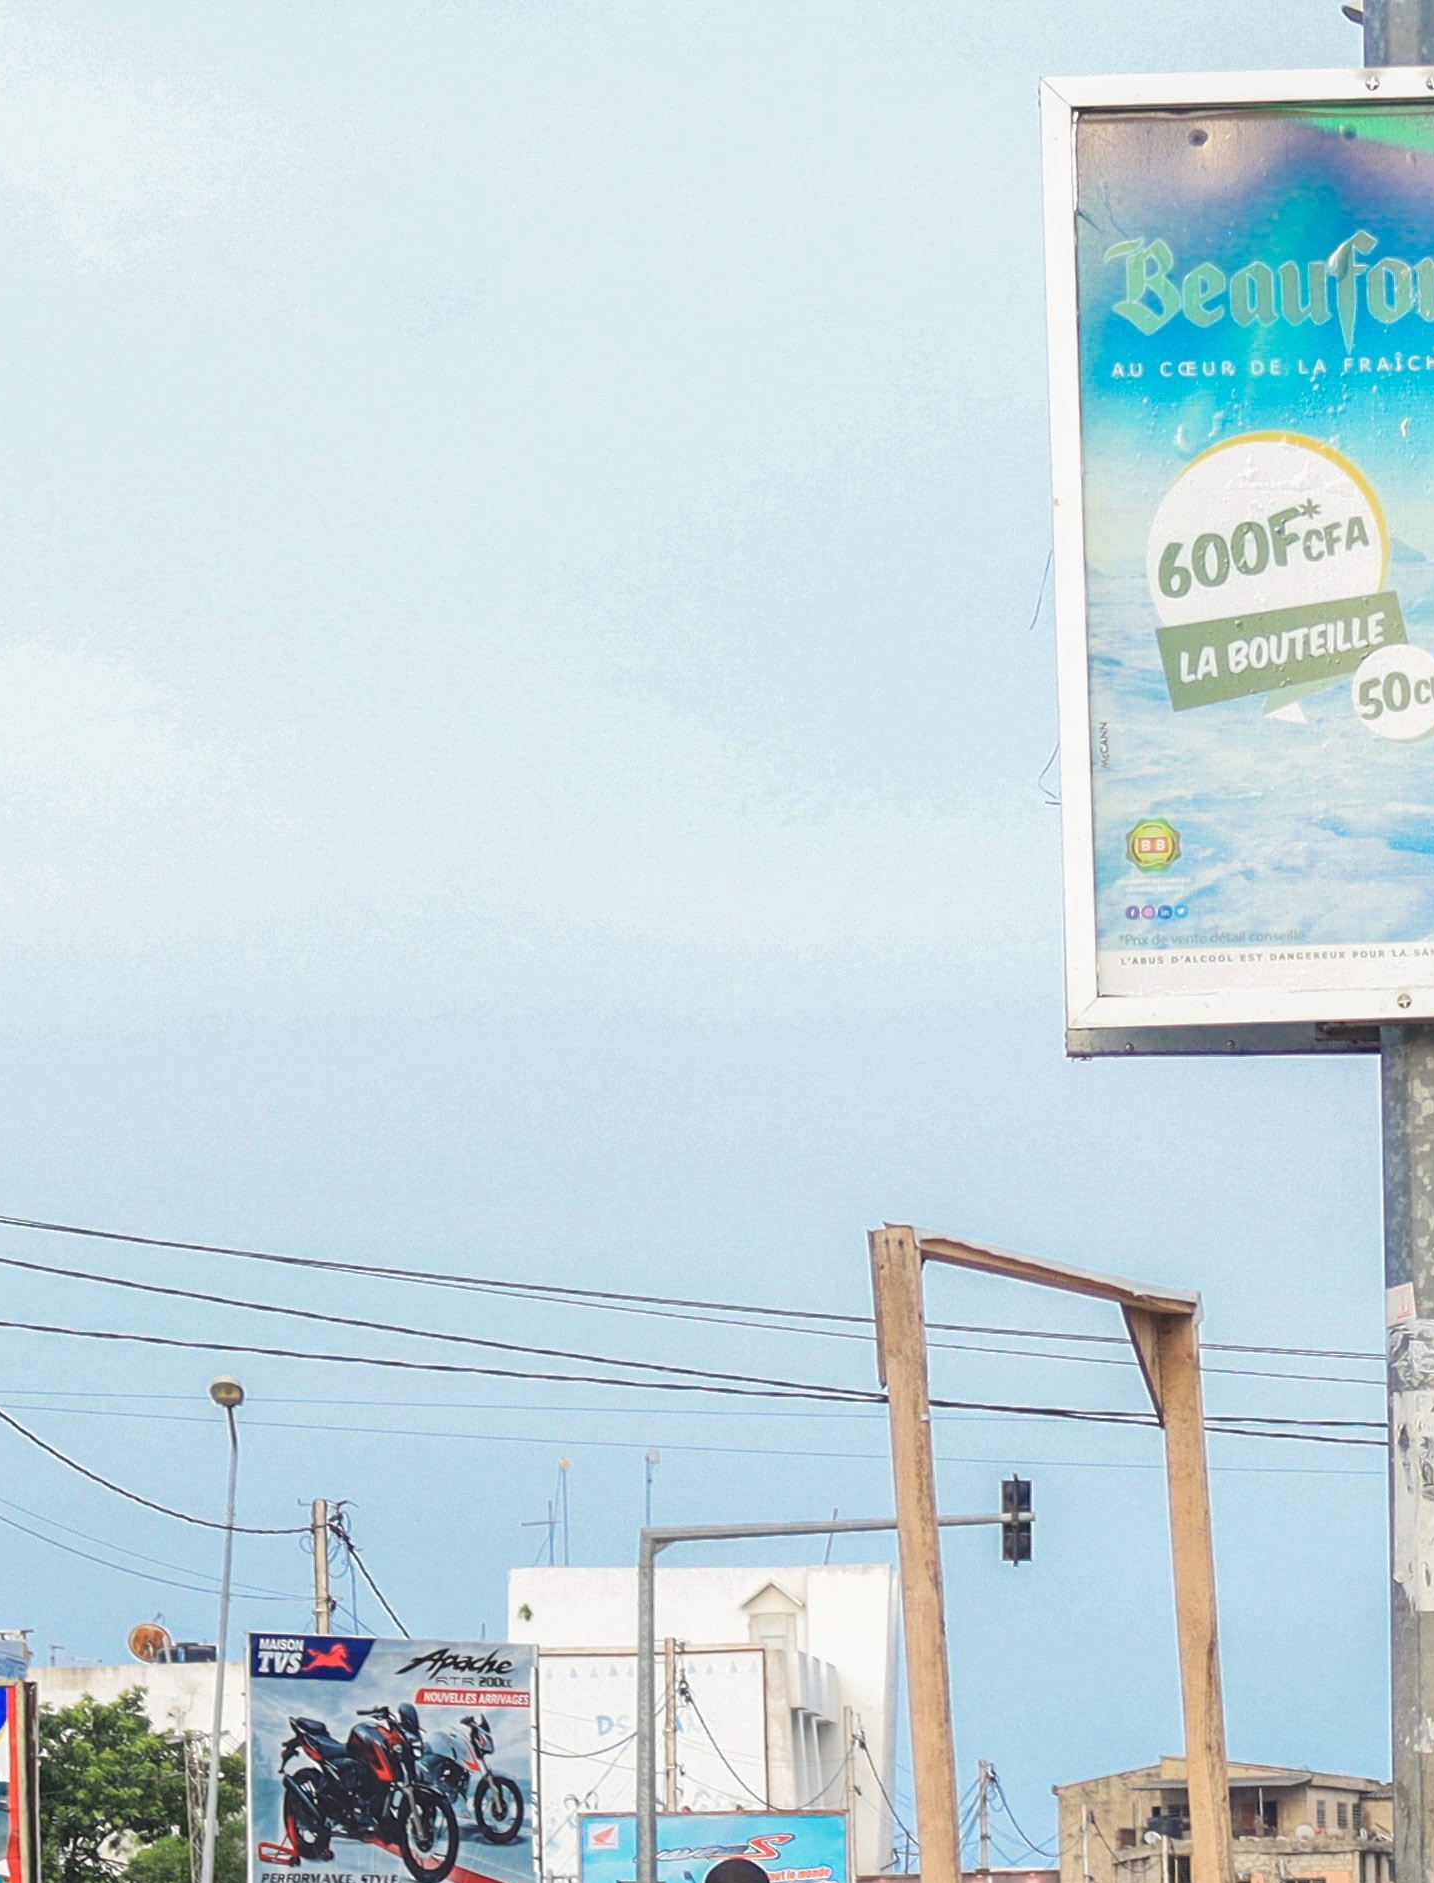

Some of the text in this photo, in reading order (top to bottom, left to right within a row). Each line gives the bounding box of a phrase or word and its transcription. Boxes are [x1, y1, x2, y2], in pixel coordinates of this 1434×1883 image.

[1111, 361, 1143, 379] AU
[1251, 360, 1283, 377] DE
[1298, 358, 1326, 376] LA
[1179, 611, 1386, 685] LA BOUTEILLE
[1169, 933, 1207, 944] vente
[1209, 931, 1246, 943] détail
[1249, 929, 1306, 942] conseillé
[1120, 955, 1165, 966] L'ABUS
[1170, 954, 1233, 965] D'ALCOOL
[1239, 953, 1264, 962] EST
[1352, 949, 1385, 959] POUR
[1392, 948, 1408, 958] LA
[258, 1638, 304, 1651] MAISON
[257, 1651, 303, 1675] TVS
[395, 1647, 516, 1680] Apache
[423, 1691, 530, 1706] NOUVELLES ARRIVAGES
[798, 1866, 832, 1879] monde
